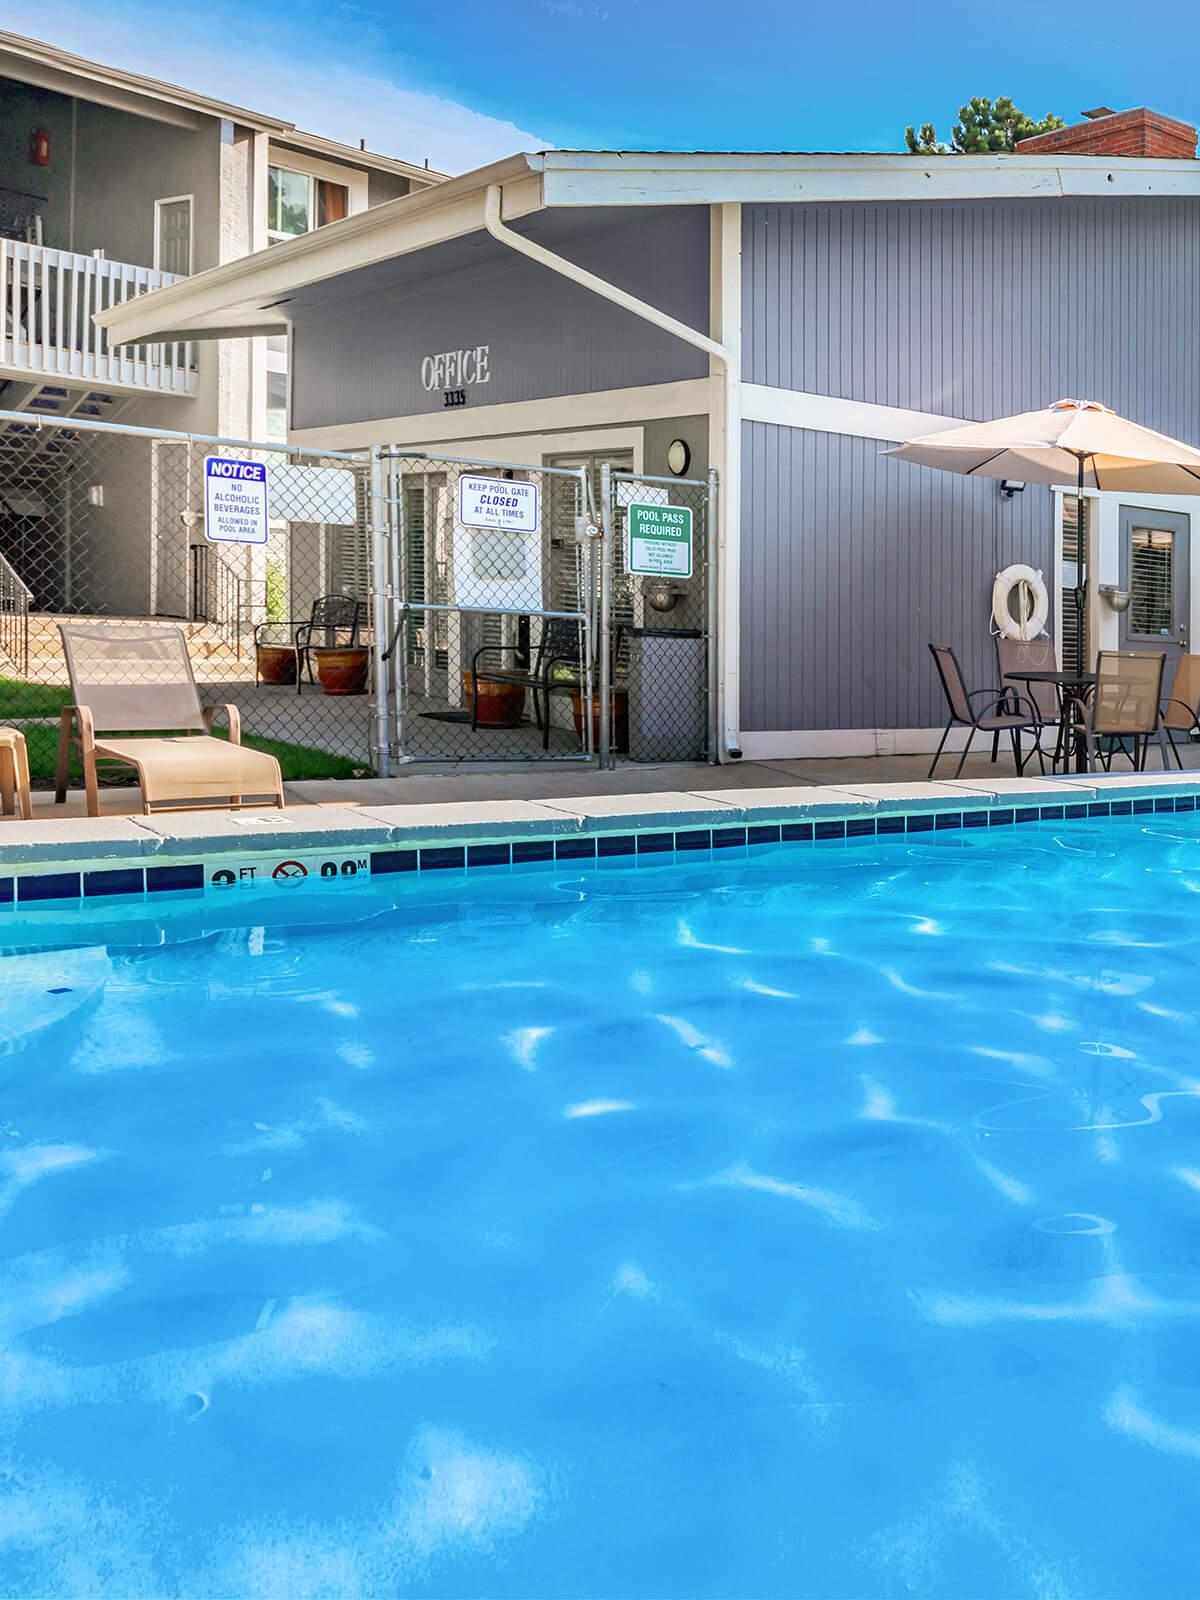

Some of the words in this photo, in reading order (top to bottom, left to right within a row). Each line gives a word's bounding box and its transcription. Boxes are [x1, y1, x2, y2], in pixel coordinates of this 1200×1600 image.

[421, 345, 490, 391] OFFICE
[443, 390, 466, 407] 3335
[211, 461, 262, 480] NOTICE
[231, 483, 243, 492] NO
[468, 483, 487, 491] KEEP
[489, 485, 509, 494] POOL
[511, 487, 529, 497] GATE
[214, 492, 260, 505] ALCOHOLIC
[479, 494, 519, 507] CLOSED
[214, 503, 260, 516] BEVERAGES
[474, 506, 483, 514] AT
[485, 507, 499, 516] ALL
[502, 509, 524, 519] TIMES
[218, 516, 249, 525] ALLOWED
[637, 510, 660, 522] POOL
[662, 512, 684, 524] PASS
[219, 524, 236, 533] POOL
[238, 526, 256, 534] AREA
[639, 523, 682, 537] REQUIRED
